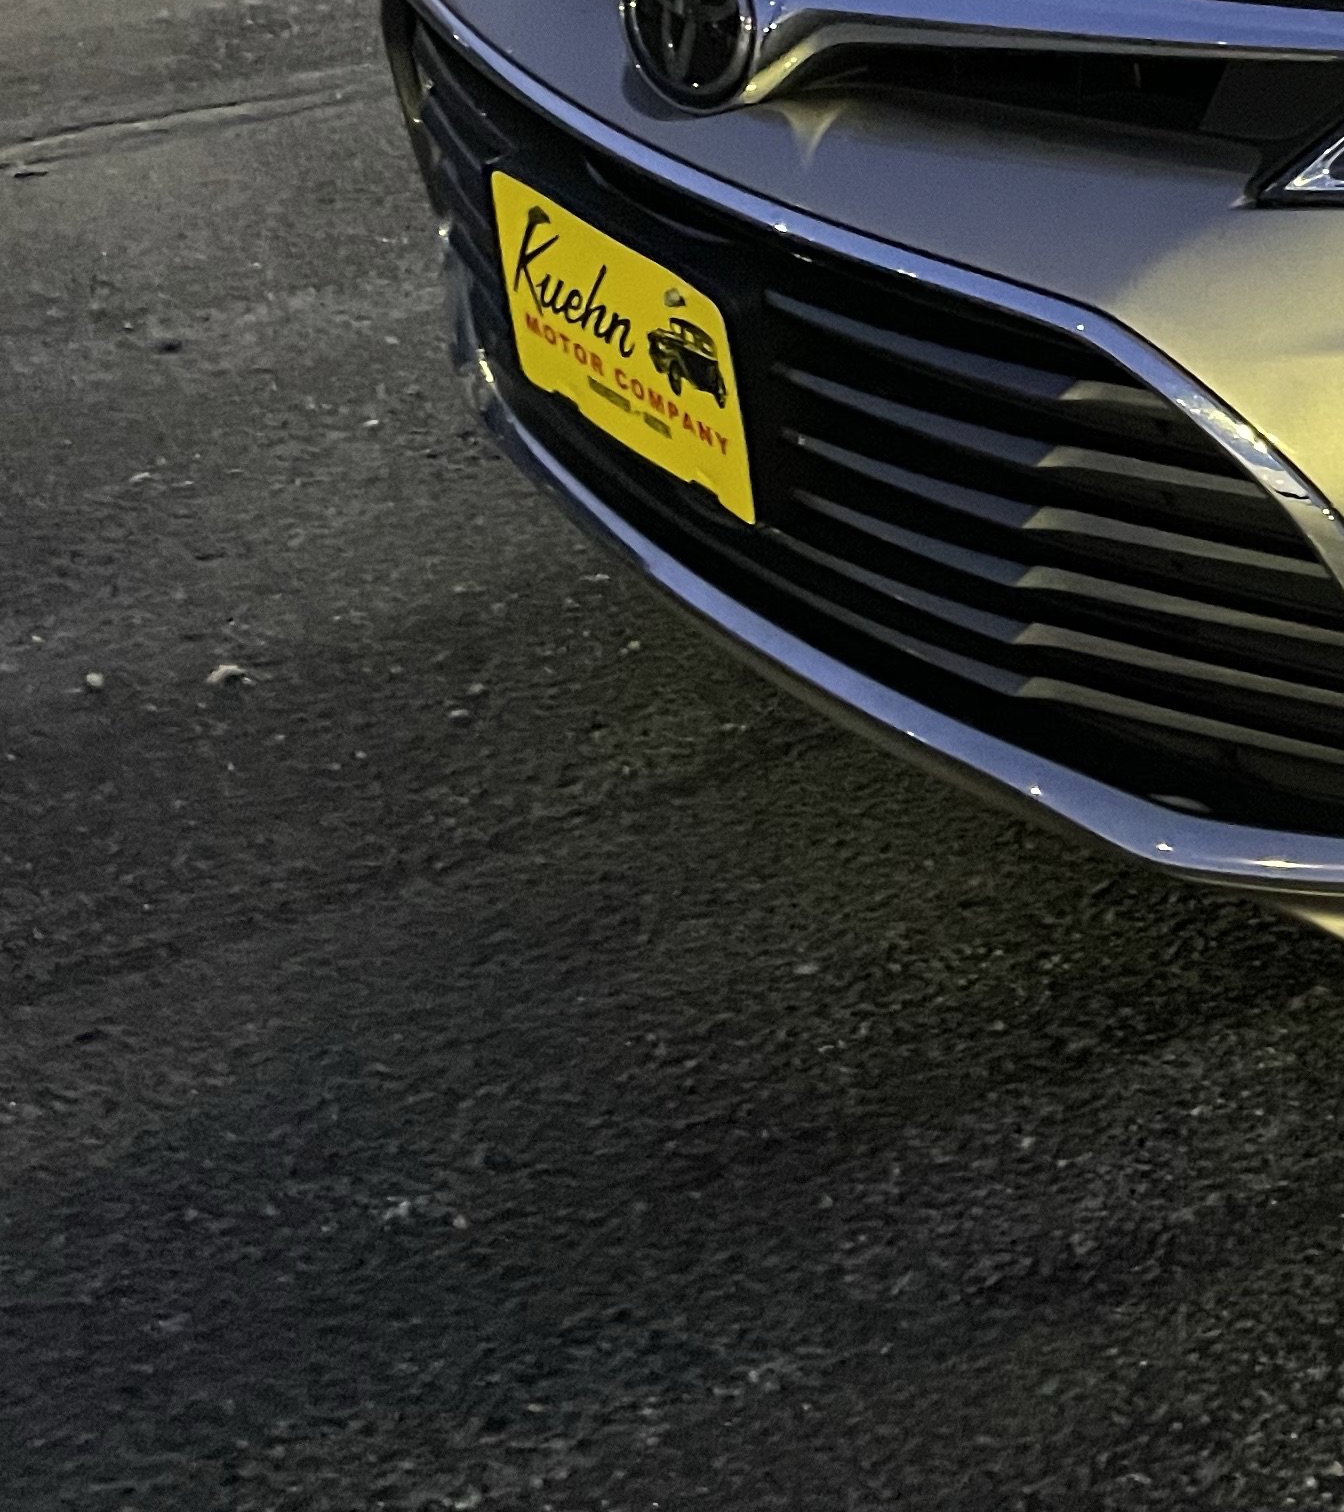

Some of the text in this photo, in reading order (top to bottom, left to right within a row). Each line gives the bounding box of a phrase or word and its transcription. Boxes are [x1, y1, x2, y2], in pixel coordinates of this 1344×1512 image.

[514, 206, 635, 358] Kuehn
[525, 313, 604, 377] MOTOR
[614, 367, 728, 456] COMPANY
